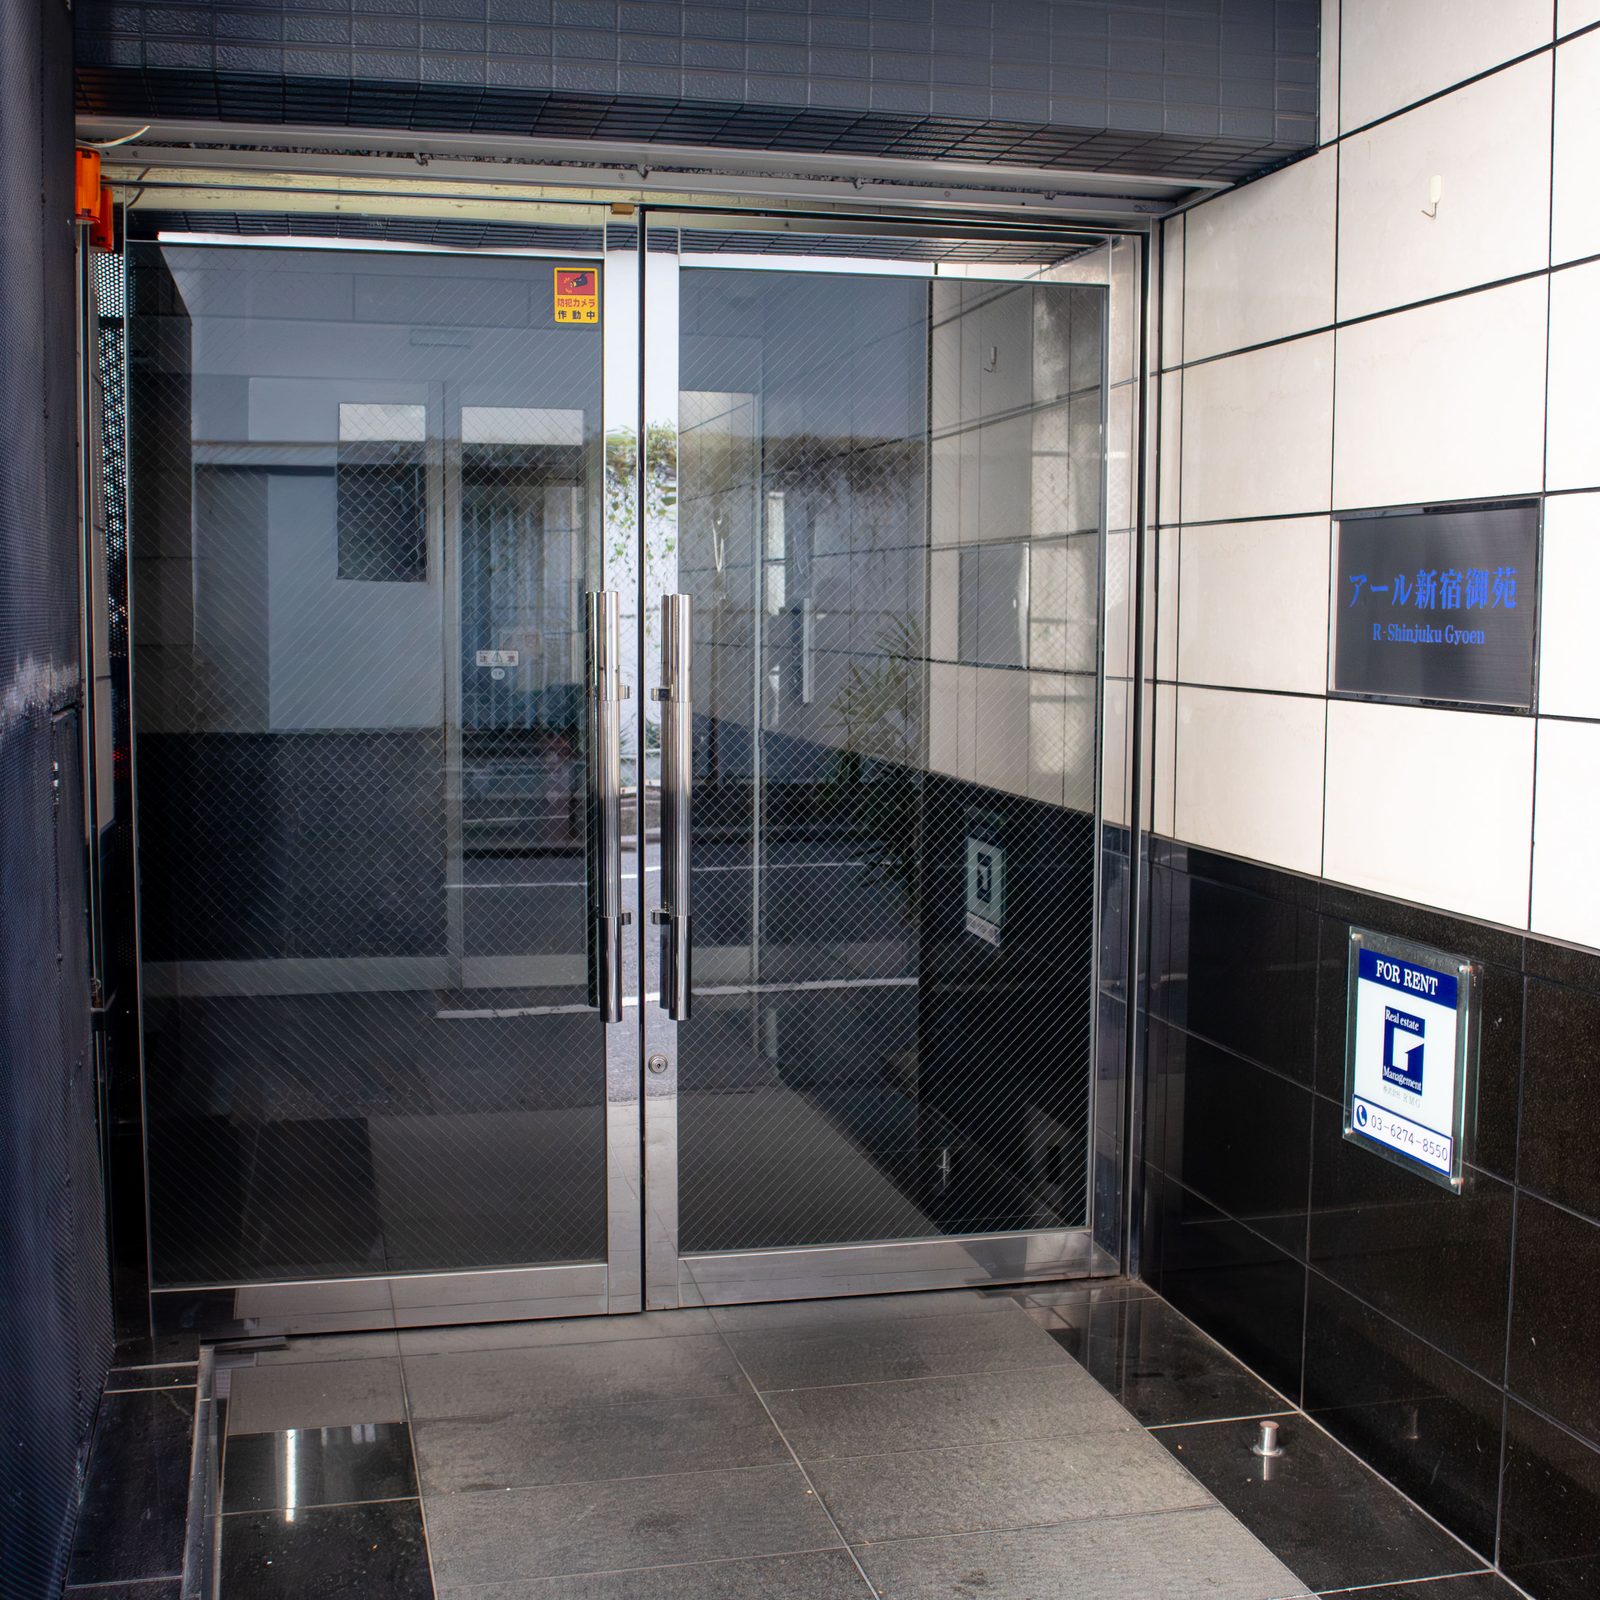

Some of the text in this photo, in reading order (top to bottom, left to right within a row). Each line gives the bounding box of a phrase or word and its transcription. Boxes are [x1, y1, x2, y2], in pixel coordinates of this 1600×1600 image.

[557, 298, 596, 308] 防犯カメラ
[557, 310, 596, 320] 作動中
[1349, 566, 1518, 610] アール新宿御苑
[1444, 624, 1485, 646] Gyoen
[1375, 959, 1439, 996] FOR RENT
[1385, 1008, 1420, 1031] Real estate
[1382, 1065, 1422, 1092] Management
[1371, 1114, 1448, 1162] 03-6274-8550
